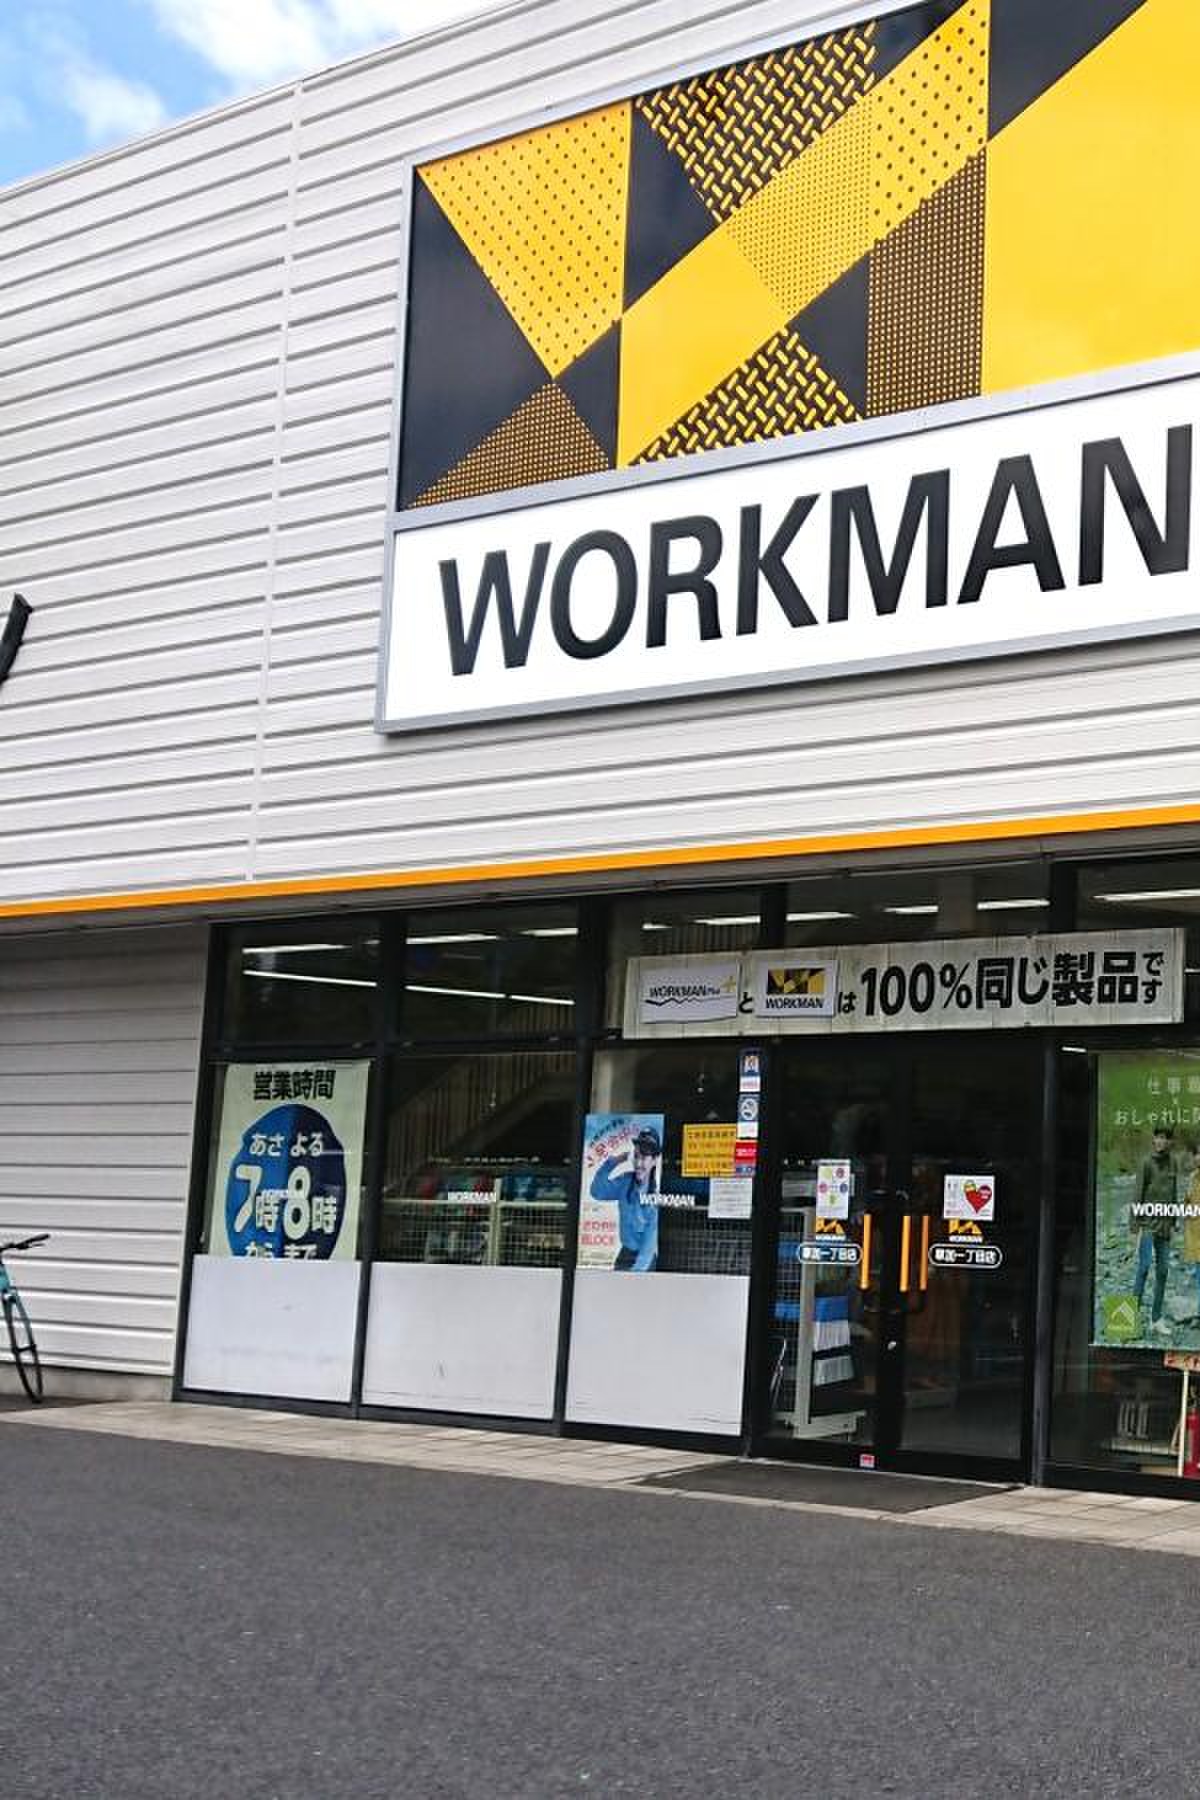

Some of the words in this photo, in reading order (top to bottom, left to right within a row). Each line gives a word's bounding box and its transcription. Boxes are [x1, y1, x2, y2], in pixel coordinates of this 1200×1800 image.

[439, 424, 1194, 677] WORKMAN
[739, 993, 754, 1014] と
[765, 997, 825, 1010] WORKMAN
[253, 1069, 337, 1101] 営業時間
[249, 1132, 285, 1157] あさ
[290, 1131, 325, 1158] よる
[638, 1192, 696, 1208] WORKMAN
